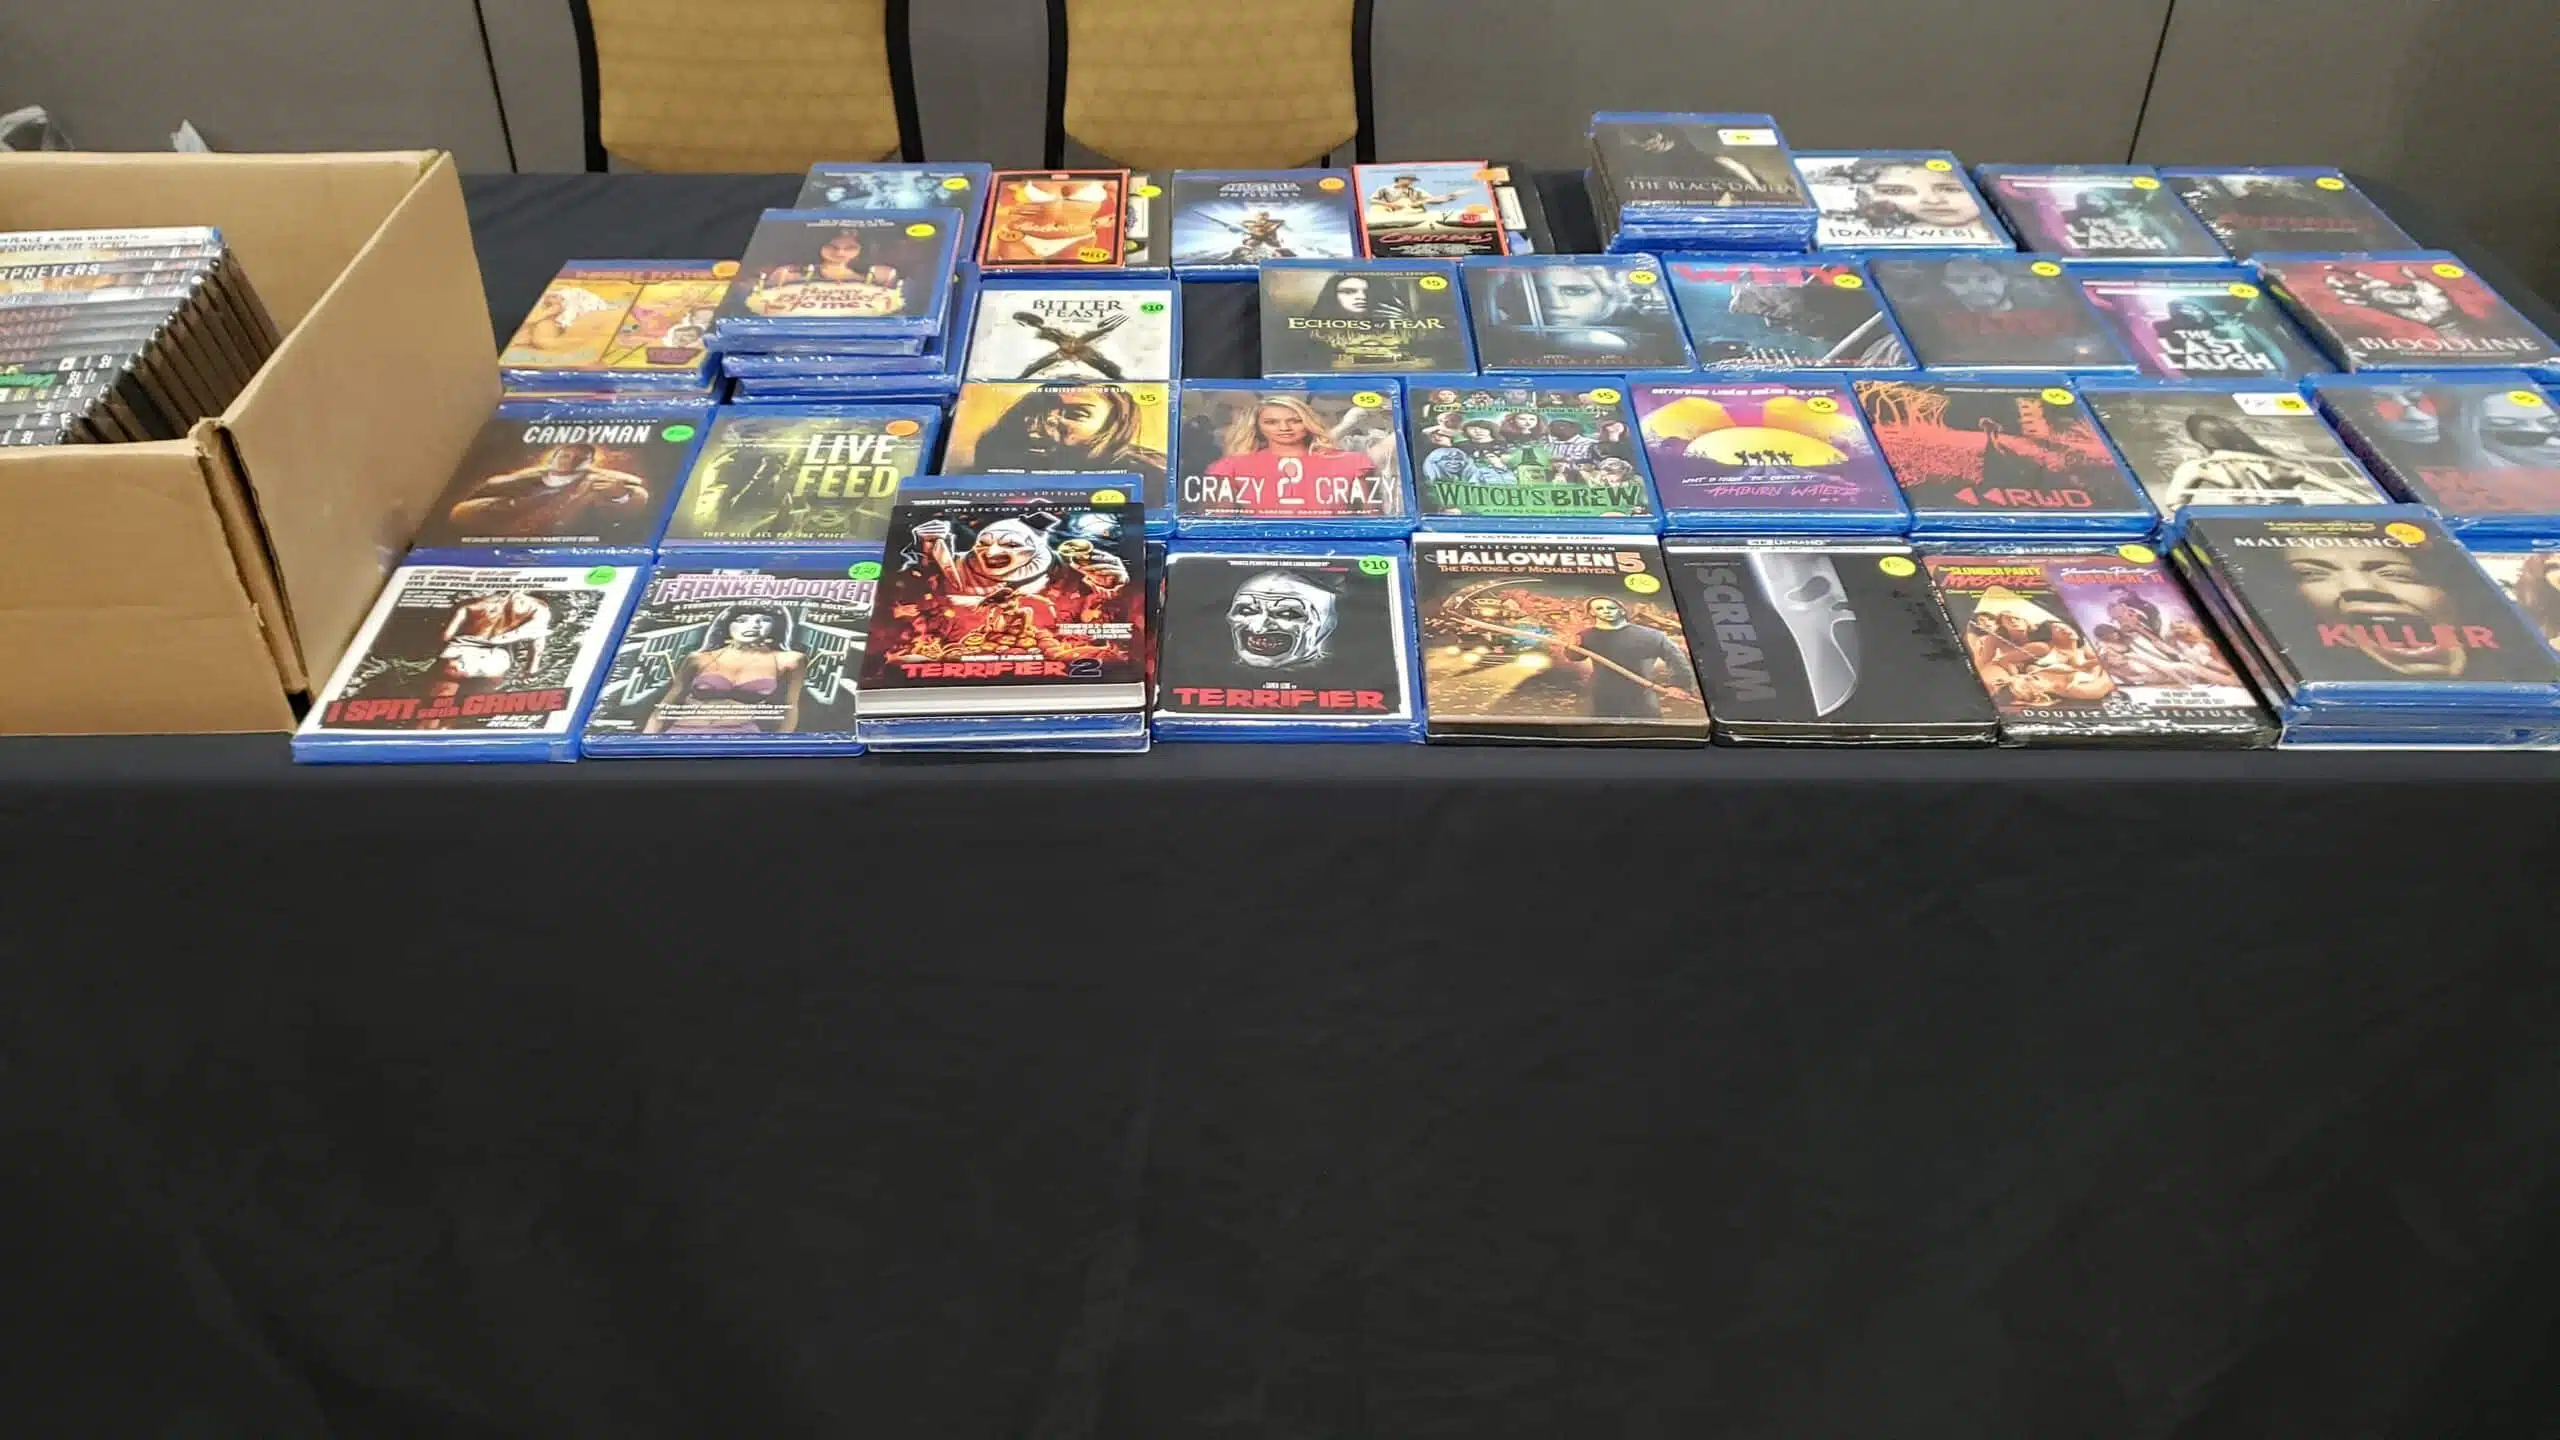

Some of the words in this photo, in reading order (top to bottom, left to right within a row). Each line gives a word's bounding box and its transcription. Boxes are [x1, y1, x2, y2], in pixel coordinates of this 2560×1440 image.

[1032, 299, 1124, 310] BITTER
[1045, 309, 1107, 318] FEAST
[1141, 302, 1164, 312] $10
[1287, 317, 1371, 330] ECHOES
[1389, 317, 1446, 330] FEAR
[2174, 329, 2212, 340] THE
[2356, 336, 2541, 351] BLOODLINE
[2158, 338, 2245, 355] LAST
[2159, 352, 2276, 370] LAUGH
[1359, 394, 1376, 404] $5
[522, 424, 651, 444] CANDYMAN
[804, 434, 897, 465] LIVE
[792, 465, 899, 498] FEED
[1184, 475, 1265, 504] CRAZY
[1276, 456, 1305, 505] 2
[1315, 476, 1396, 505] CRAZY
[1434, 484, 1545, 506] WITCH'S
[1552, 486, 1641, 507] BREW
[2004, 487, 2093, 508] RWD
[1459, 543, 1551, 551] COLLECTOR'S
[1362, 558, 1390, 570] $10
[1436, 549, 1615, 567] HALLOWEEN
[1615, 551, 1646, 573] 5
[1439, 564, 1459, 573] THE
[1461, 565, 1511, 574] REVENGE
[1528, 565, 1577, 574] MICHAEL
[1577, 566, 1616, 575] MYERS
[653, 578, 878, 604] FRANKENHOOKER
[1696, 566, 1777, 702] SCREAM
[2316, 624, 2499, 649] KILLER
[901, 661, 1069, 679] TERRIFIER
[1068, 658, 1102, 678] 2
[325, 700, 341, 723] I
[342, 697, 420, 722] SPIT
[460, 688, 566, 717] GRAVE
[1172, 686, 1389, 711] TERRIFIER
[2022, 709, 2100, 719] DOUBLE
[2160, 709, 2252, 719] FEATURE
